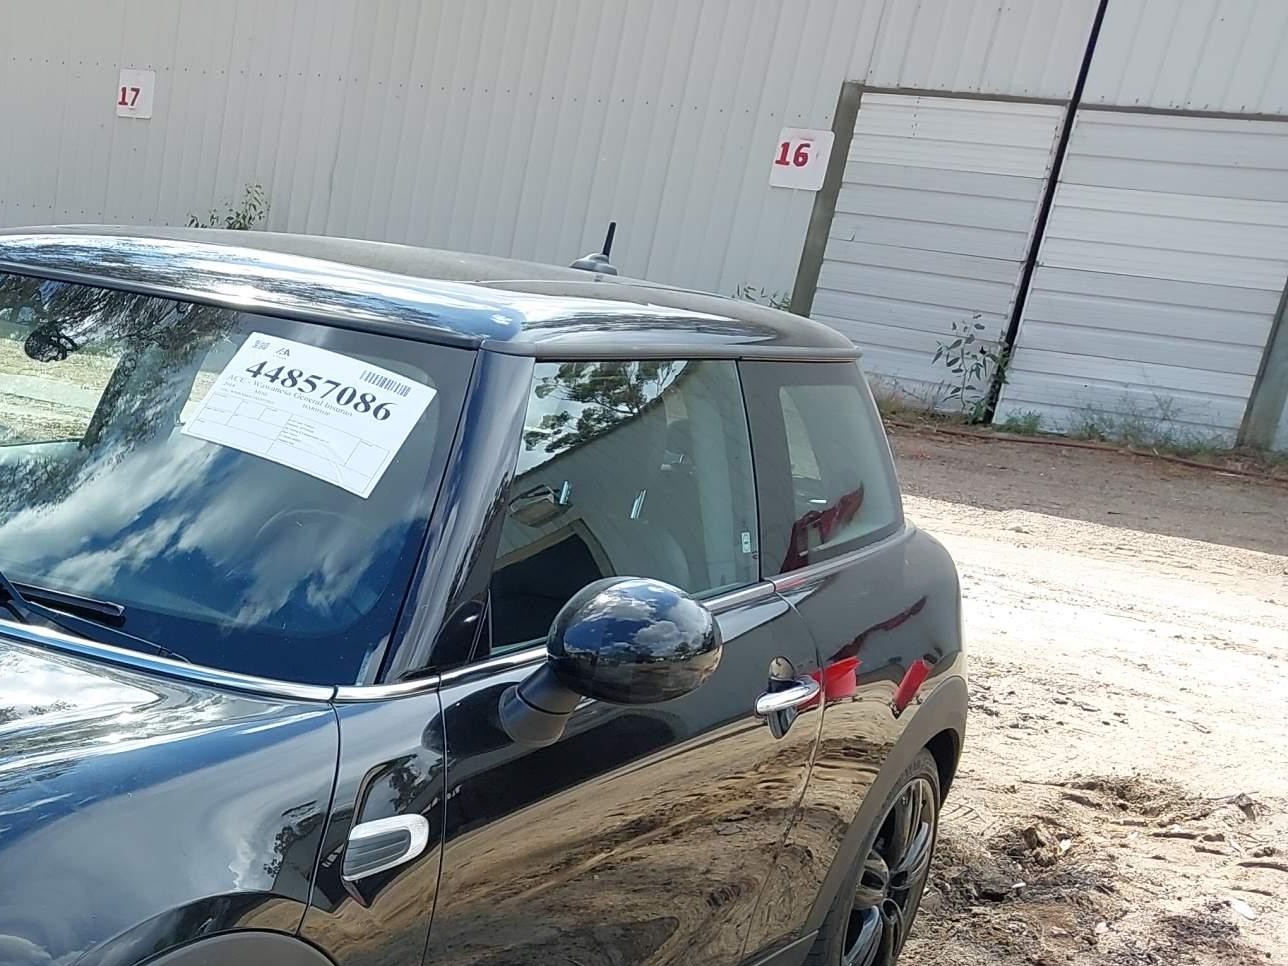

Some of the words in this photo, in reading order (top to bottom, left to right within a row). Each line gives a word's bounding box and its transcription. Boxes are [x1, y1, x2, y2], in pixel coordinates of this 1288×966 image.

[118, 86, 141, 107] 17
[775, 141, 811, 167] 16
[245, 361, 399, 420] 44857086
[293, 391, 326, 408] General
